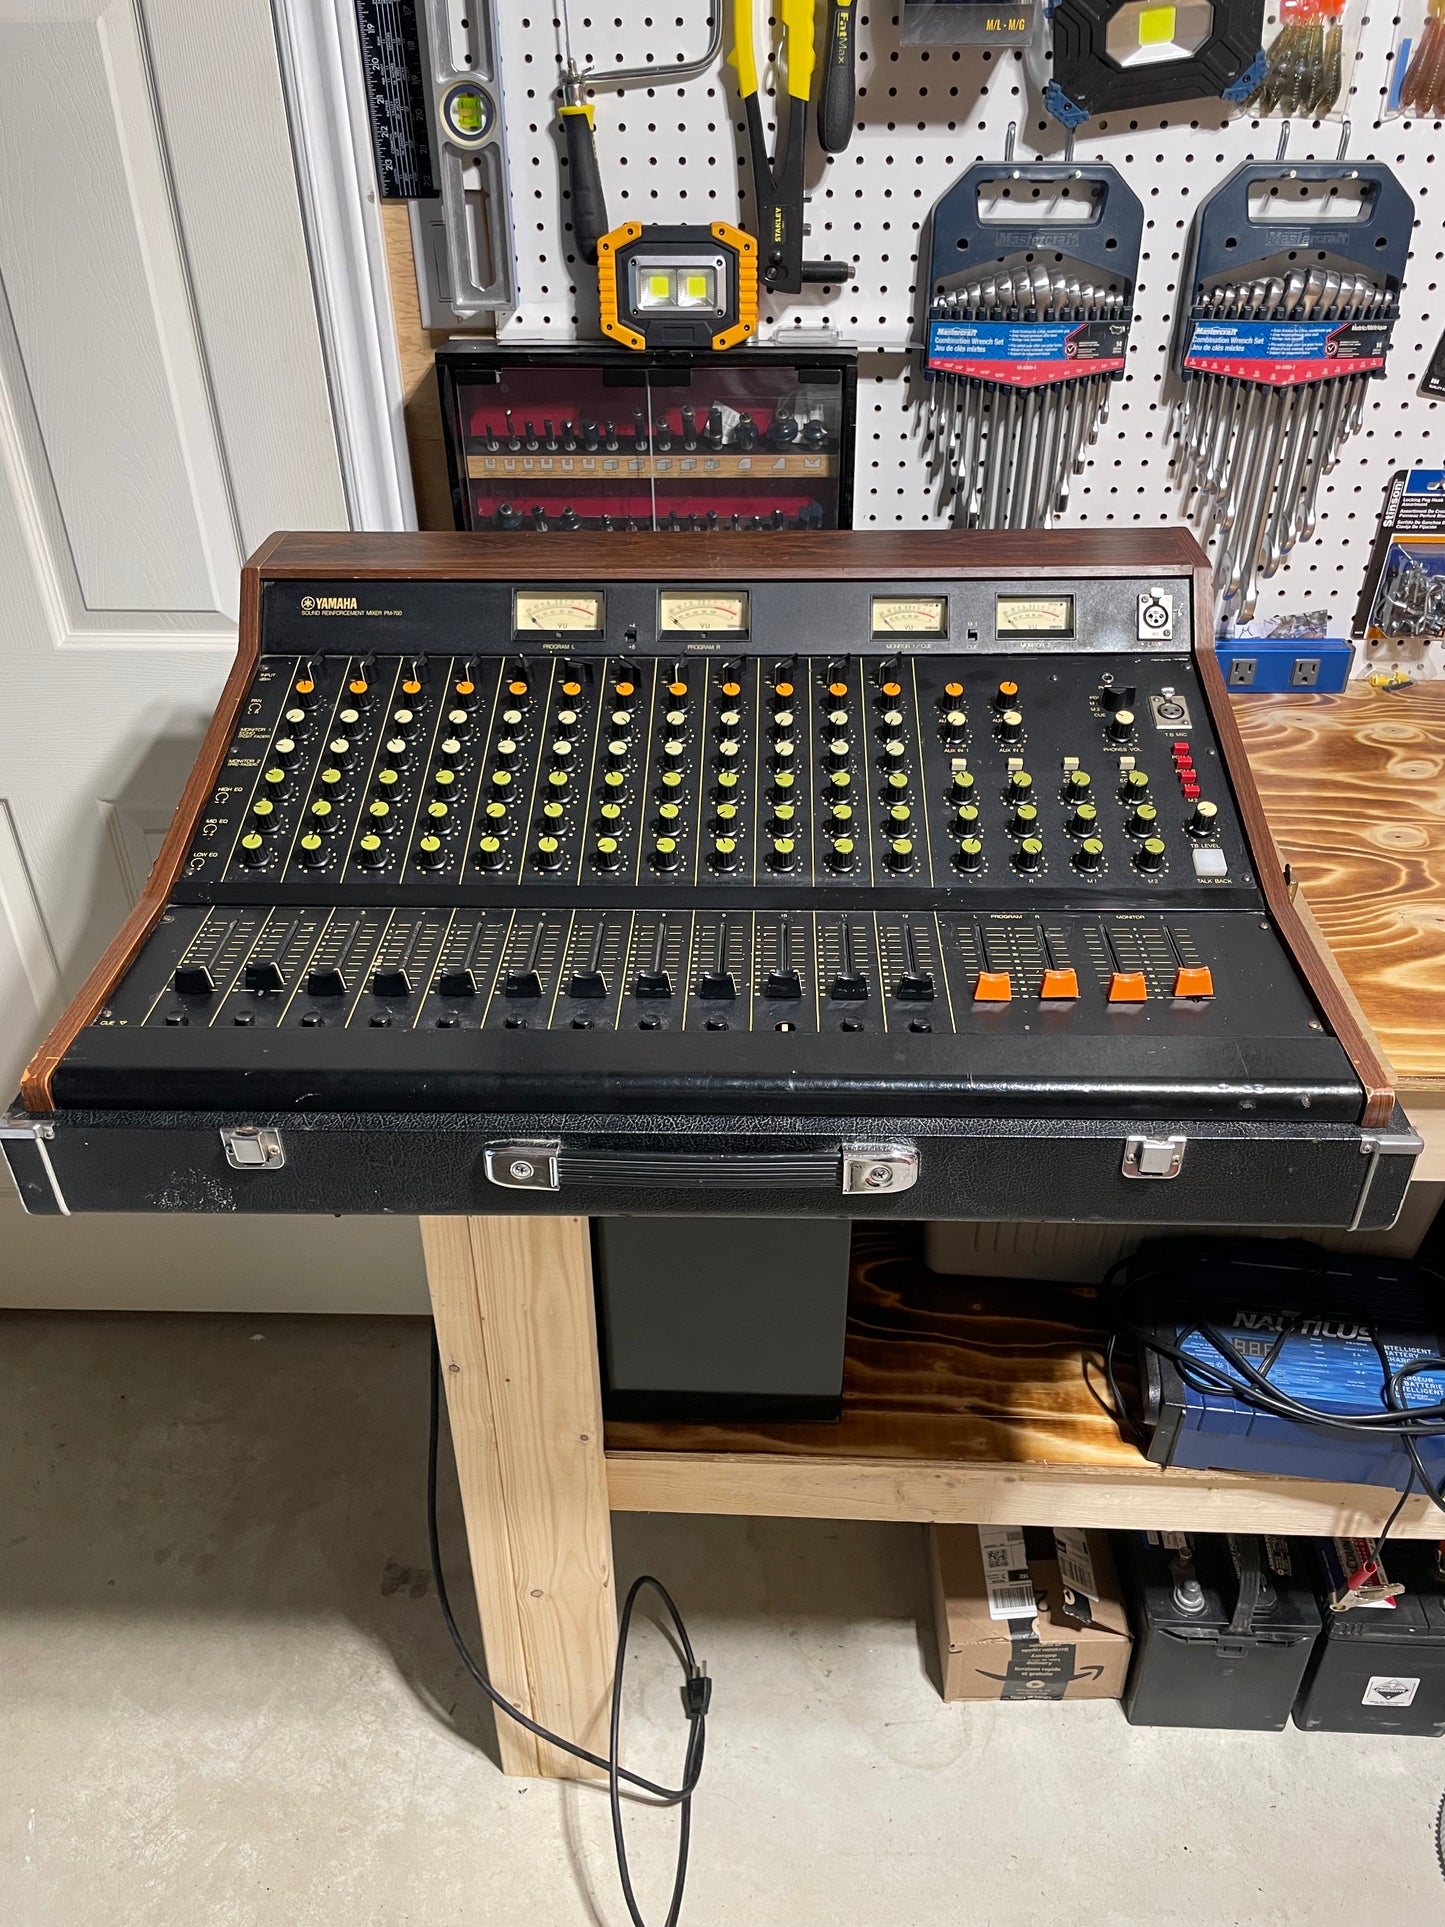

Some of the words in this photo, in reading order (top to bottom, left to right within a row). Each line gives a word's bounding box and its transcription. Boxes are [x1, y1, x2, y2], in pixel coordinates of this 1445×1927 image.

[367, 23, 375, 34] 19
[986, 19, 1001, 31] M/L
[1008, 19, 1025, 31] M/G
[837, 12, 849, 64] FatMax
[371, 57, 380, 70] 20
[376, 94, 385, 105] 21
[380, 125, 389, 138] 22
[385, 159, 393, 171] 23
[937, 327, 978, 337] Mastercraft
[1195, 326, 1238, 336] Mastercraft
[935, 337, 970, 345] Combination
[994, 338, 1004, 346] Set
[1192, 336, 1229, 344] Combination
[1230, 337, 1252, 345] Wrench
[1253, 337, 1264, 345] Set
[967, 345, 986, 353] mixtes
[1225, 344, 1245, 352] mixtes
[1383, 481, 1404, 527] Stinson
[316, 597, 358, 610] YAMAHA
[1232, 1311, 1373, 1342] NAUTILUS
[1383, 1344, 1431, 1355] NTELLIGENT
